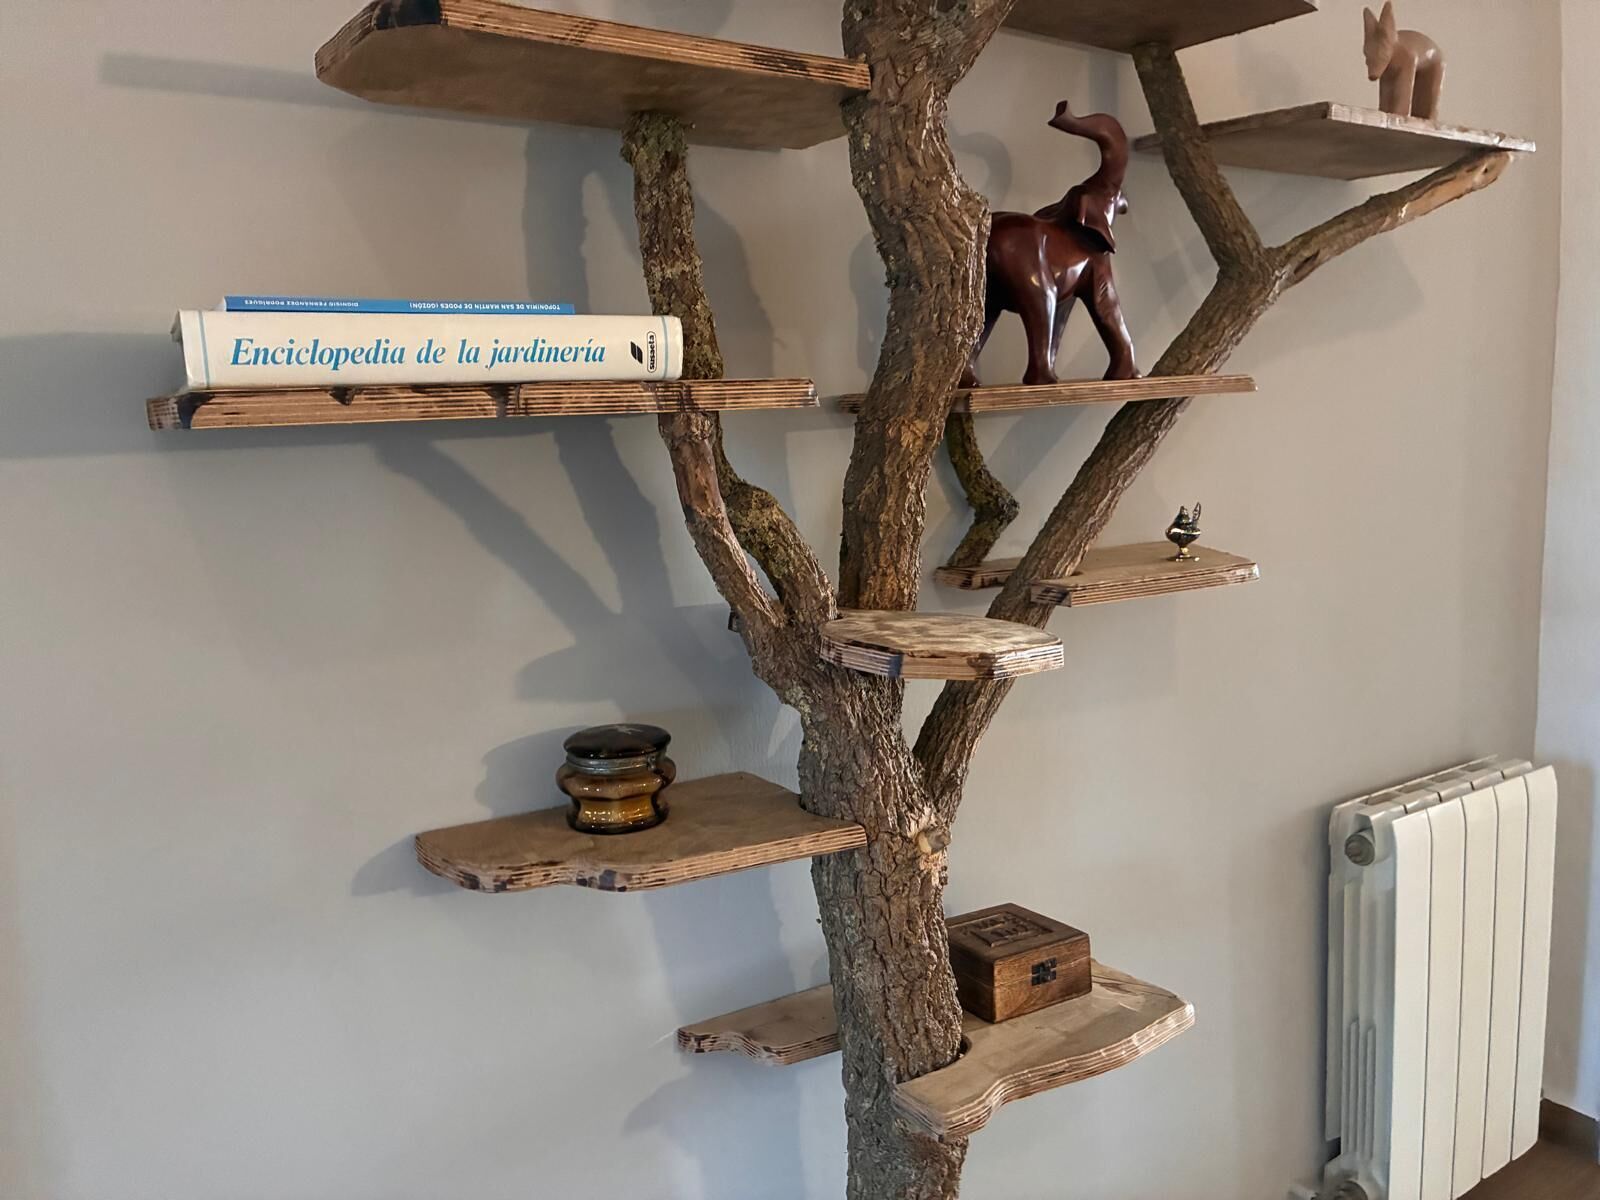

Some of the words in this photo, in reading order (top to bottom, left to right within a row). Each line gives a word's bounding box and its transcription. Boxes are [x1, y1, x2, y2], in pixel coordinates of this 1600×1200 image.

[230, 338, 406, 371] Enciclopedia
[416, 338, 446, 364] de
[457, 338, 480, 364] la
[485, 337, 606, 370] jardinería
